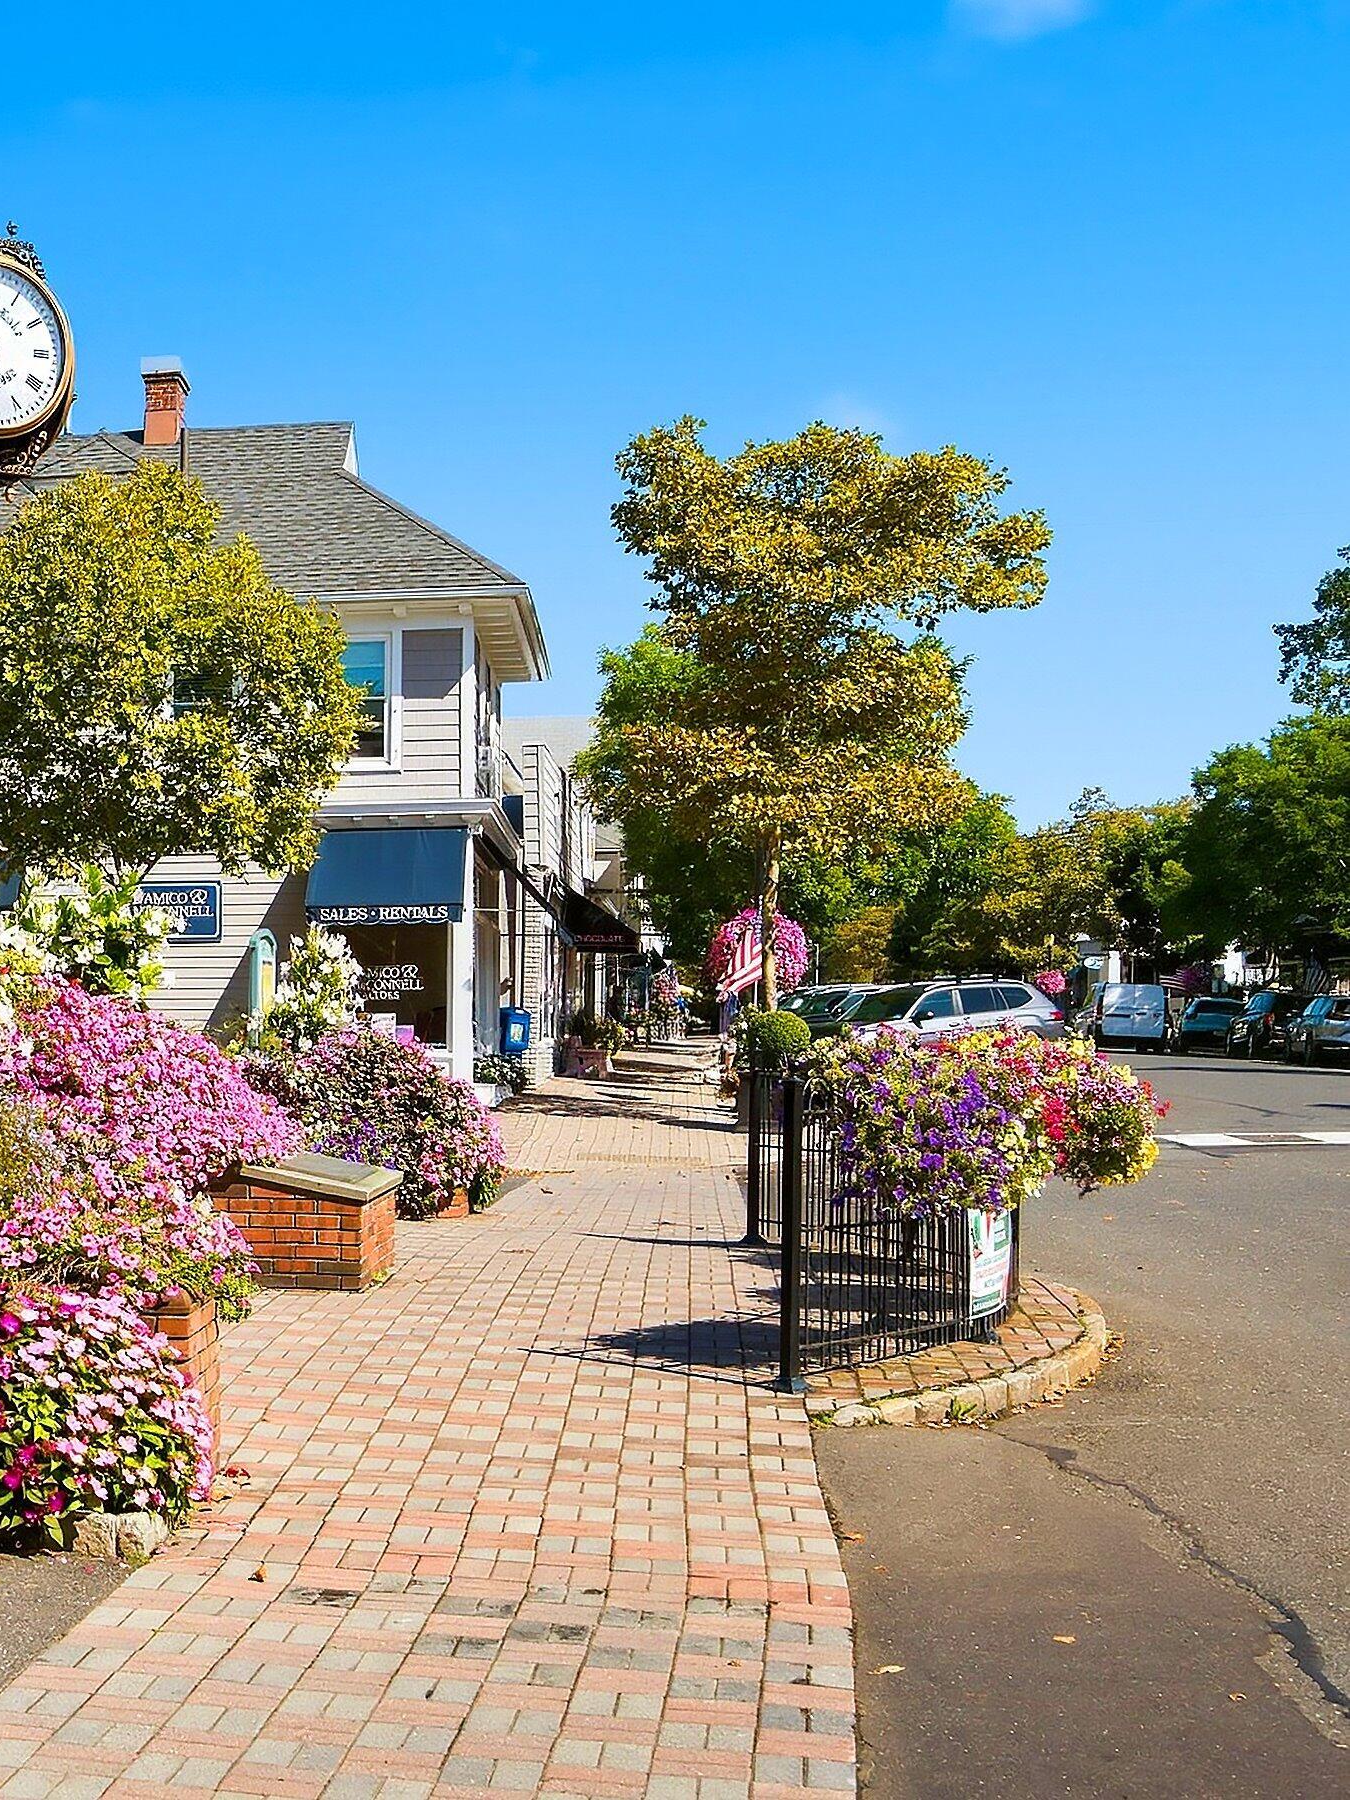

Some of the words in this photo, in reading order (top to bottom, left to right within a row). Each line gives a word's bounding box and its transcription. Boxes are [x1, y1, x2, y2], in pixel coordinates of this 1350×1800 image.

[320, 907, 367, 920] SALES
[379, 905, 448, 920] RENTALS
[574, 934, 625, 943] CHOCOLATE
